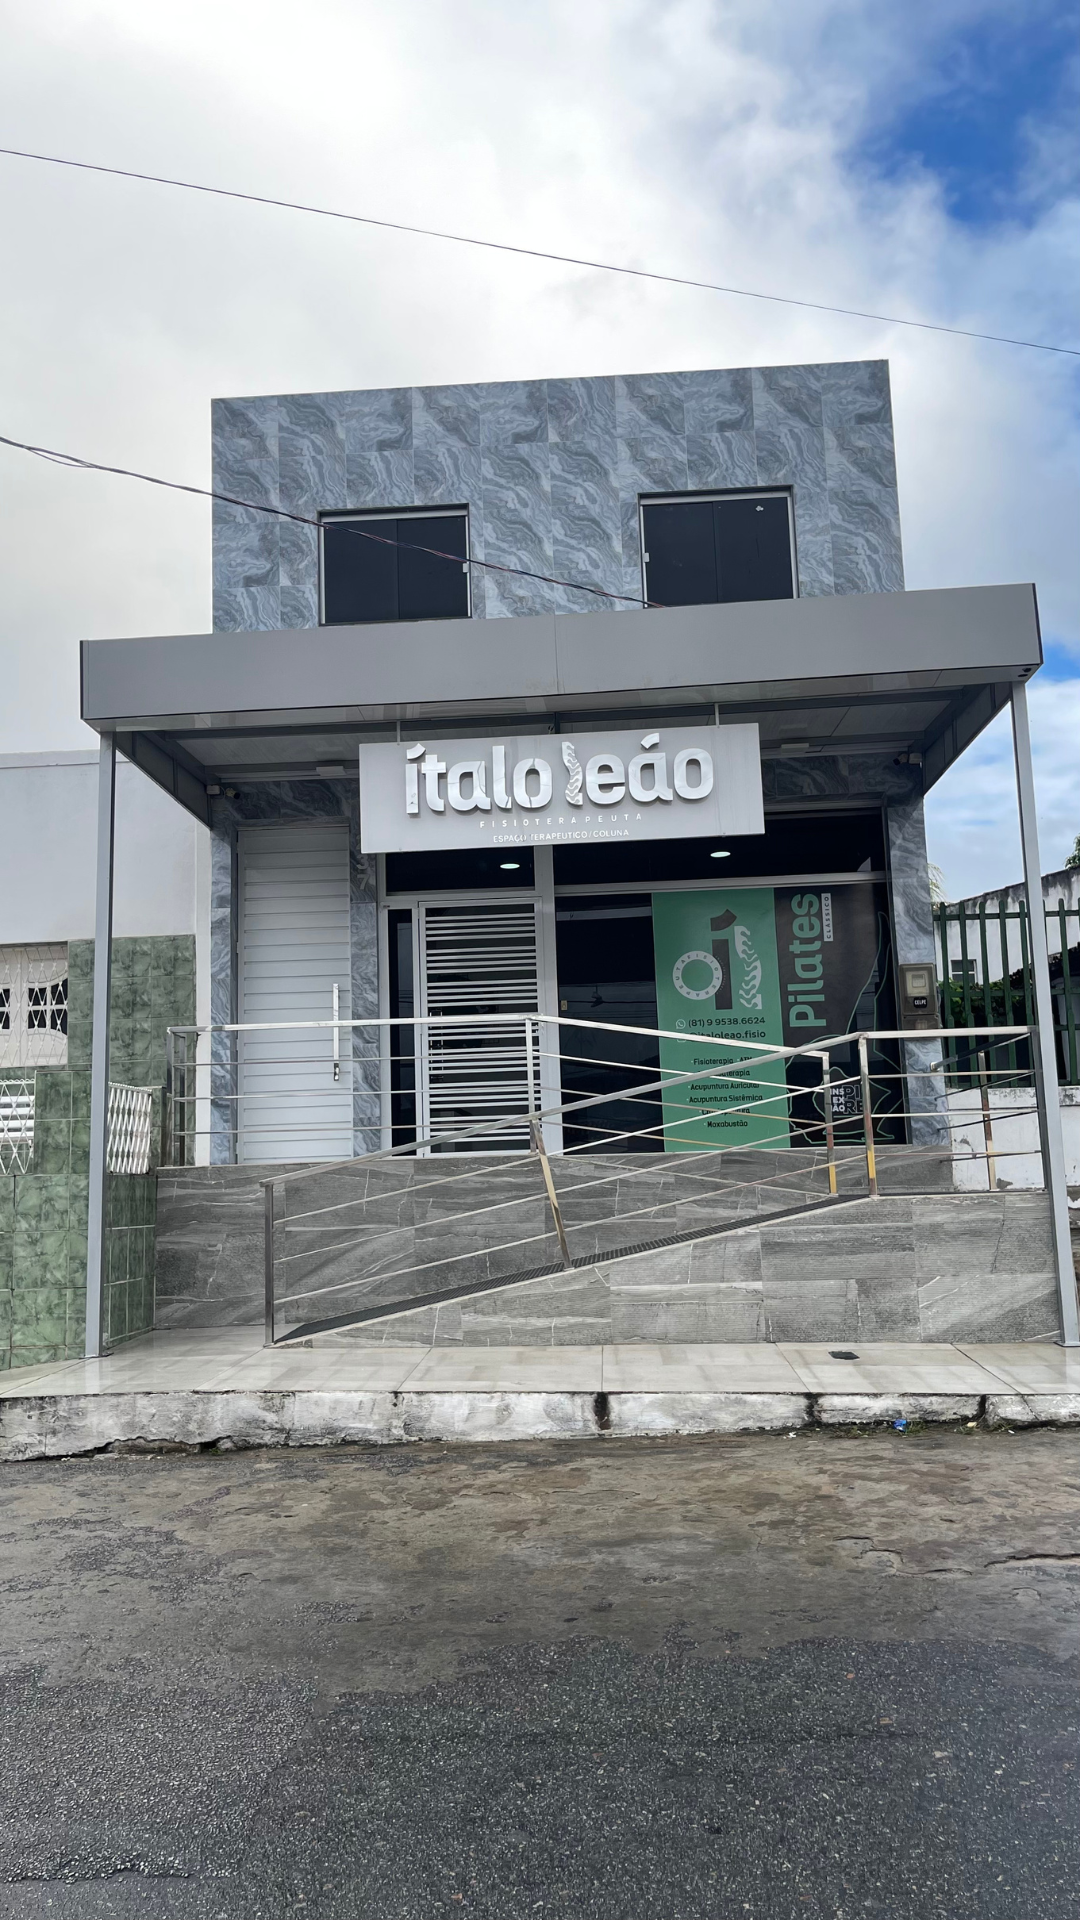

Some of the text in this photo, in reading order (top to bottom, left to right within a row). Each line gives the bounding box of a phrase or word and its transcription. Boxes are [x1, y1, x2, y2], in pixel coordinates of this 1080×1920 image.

[480, 813, 642, 828] FISIOTERAPEUTA
[493, 834, 527, 843] ESPAÇO
[787, 893, 827, 1027] Pilates
[688, 1016, 766, 1028] (81) 9 9538.6624
[693, 1057, 734, 1065] Fisioterapia
[690, 1083, 729, 1091] Acupuntura
[689, 1096, 728, 1104] Acupuntura
[831, 1103, 845, 1112] ÃO
[707, 1120, 748, 1128] Moxabustão
